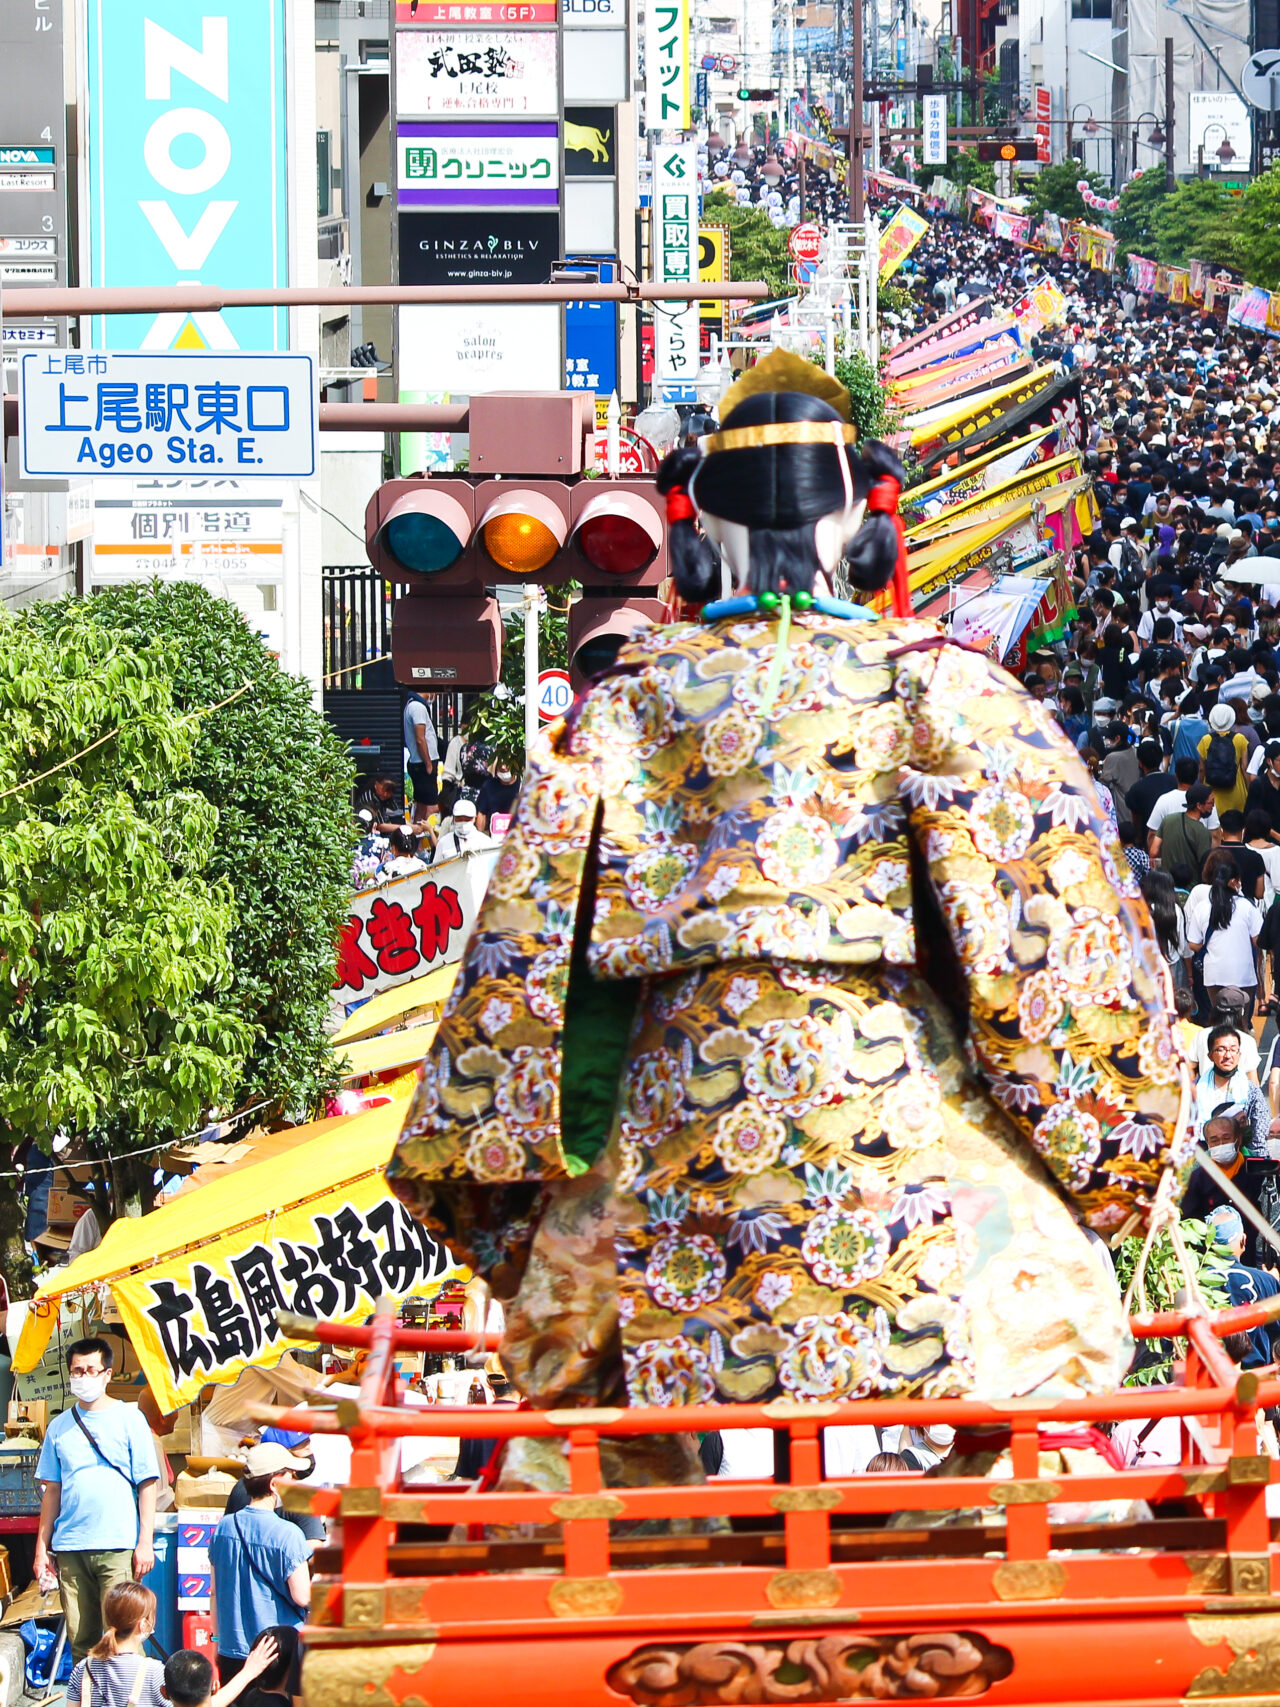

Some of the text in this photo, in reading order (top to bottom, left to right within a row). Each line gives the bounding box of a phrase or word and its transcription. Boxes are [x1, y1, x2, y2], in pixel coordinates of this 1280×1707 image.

[428, 45, 508, 78] 武田塾
[40, 125, 53, 143] 4
[0, 150, 40, 163] NOVA
[41, 216, 53, 232] 3
[14, 240, 49, 251] ユリウス
[419, 240, 539, 251] GINZA BLV
[664, 195, 689, 302] 買取専
[447, 269, 513, 279] www.ginza-blv.jp
[42, 354, 108, 375] 上尾市
[44, 381, 290, 435] 上尾駅東口
[77, 436, 264, 469] Ageo Sta. E.
[541, 684, 569, 708] 40
